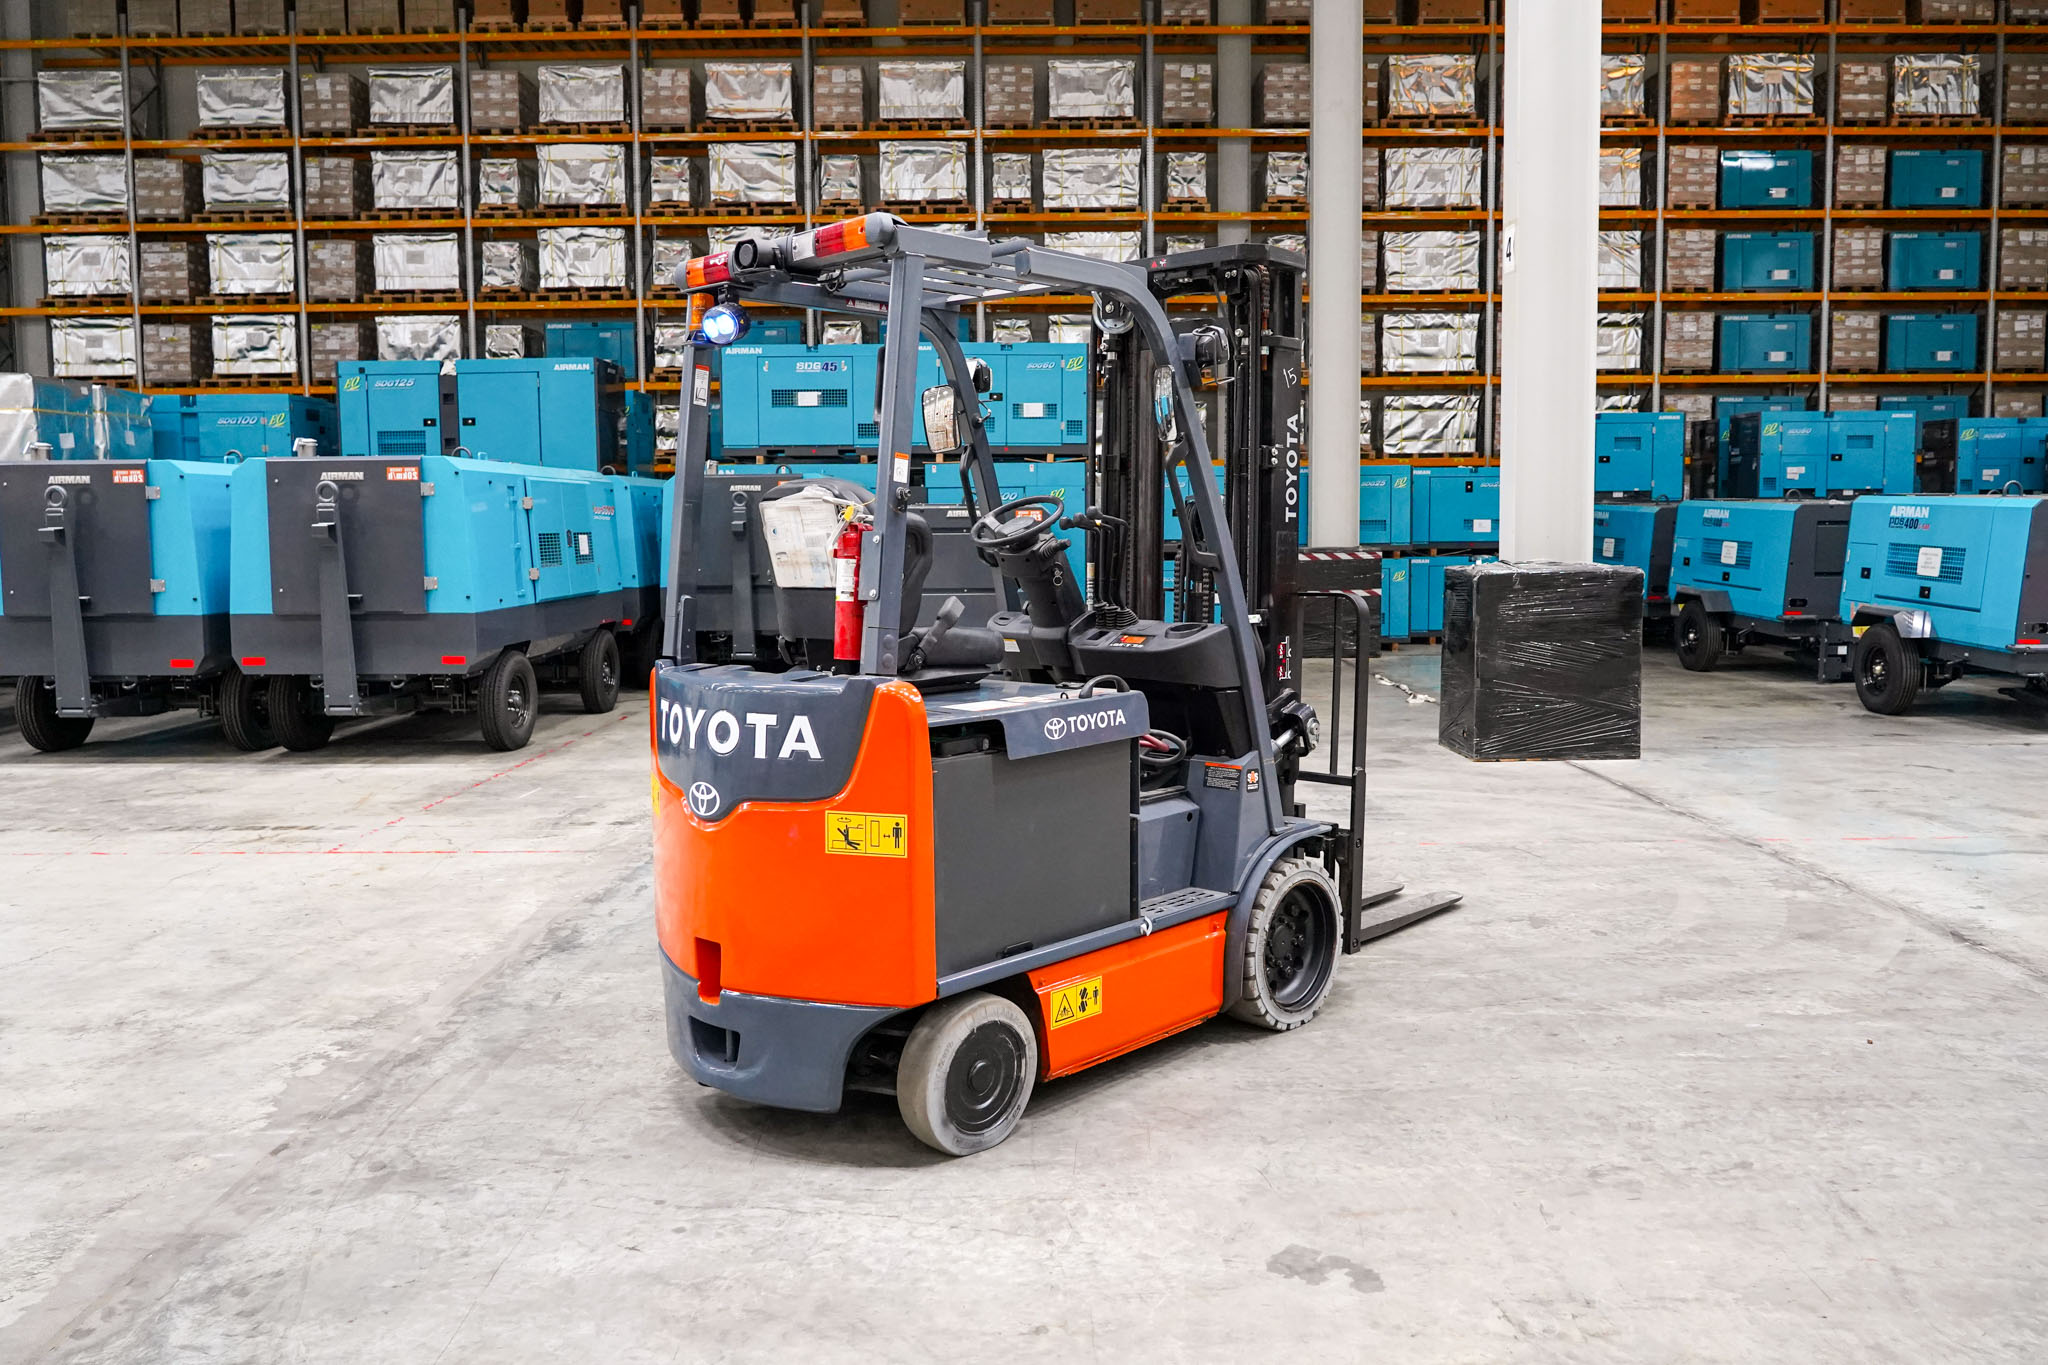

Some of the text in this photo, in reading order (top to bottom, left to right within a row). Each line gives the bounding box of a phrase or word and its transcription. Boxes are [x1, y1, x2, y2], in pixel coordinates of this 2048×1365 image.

[1506, 237, 1511, 261] 4
[320, 472, 364, 480] AIRMAN
[1285, 414, 1299, 522] TOYOTA
[48, 476, 91, 484] AIRMAN
[1703, 509, 1729, 518] AIRMAN
[1889, 505, 1929, 518] AIRMAN
[660, 698, 823, 761] TOYOTA
[1068, 709, 1126, 733] TOYOTA
